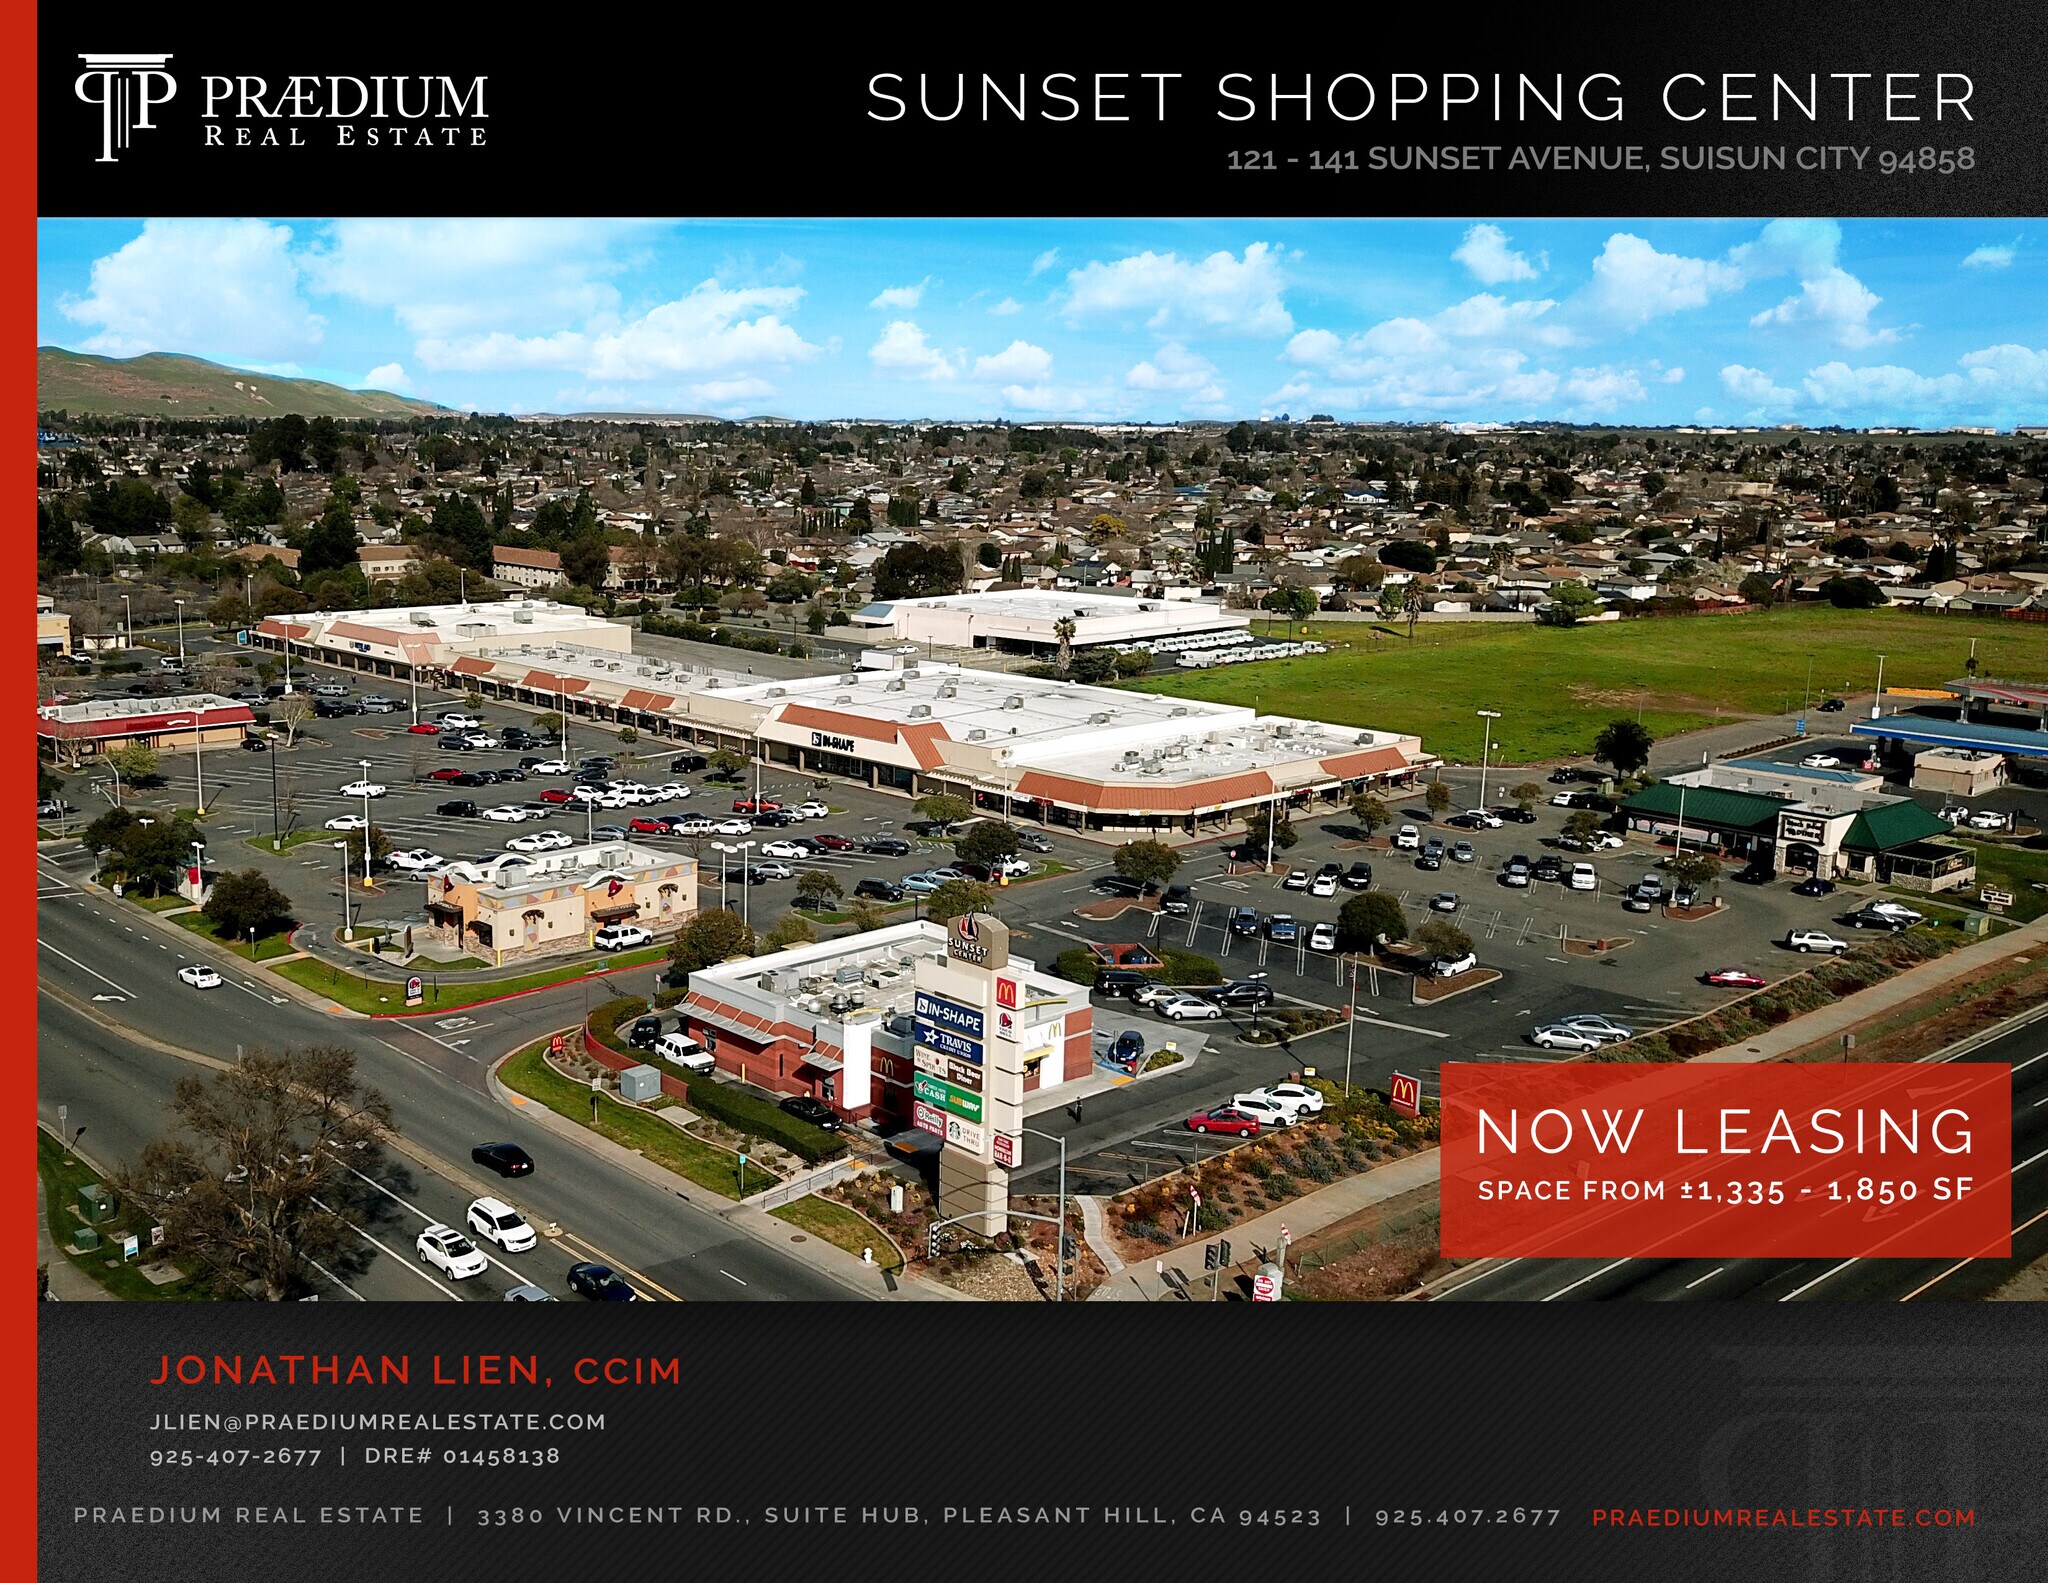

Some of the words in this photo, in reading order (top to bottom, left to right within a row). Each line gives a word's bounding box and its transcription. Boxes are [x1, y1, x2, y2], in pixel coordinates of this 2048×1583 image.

[948, 937, 988, 957] SUNSET
[953, 949, 982, 963] CENTER
[928, 1002, 981, 1031] IN-SHAPE
[940, 1033, 972, 1053] TRAVIS
[924, 1087, 946, 1102] CASH
[949, 1095, 980, 1112] SUBWAY
[962, 1127, 980, 1139] DRIVE
[963, 1135, 980, 1147] THRU
